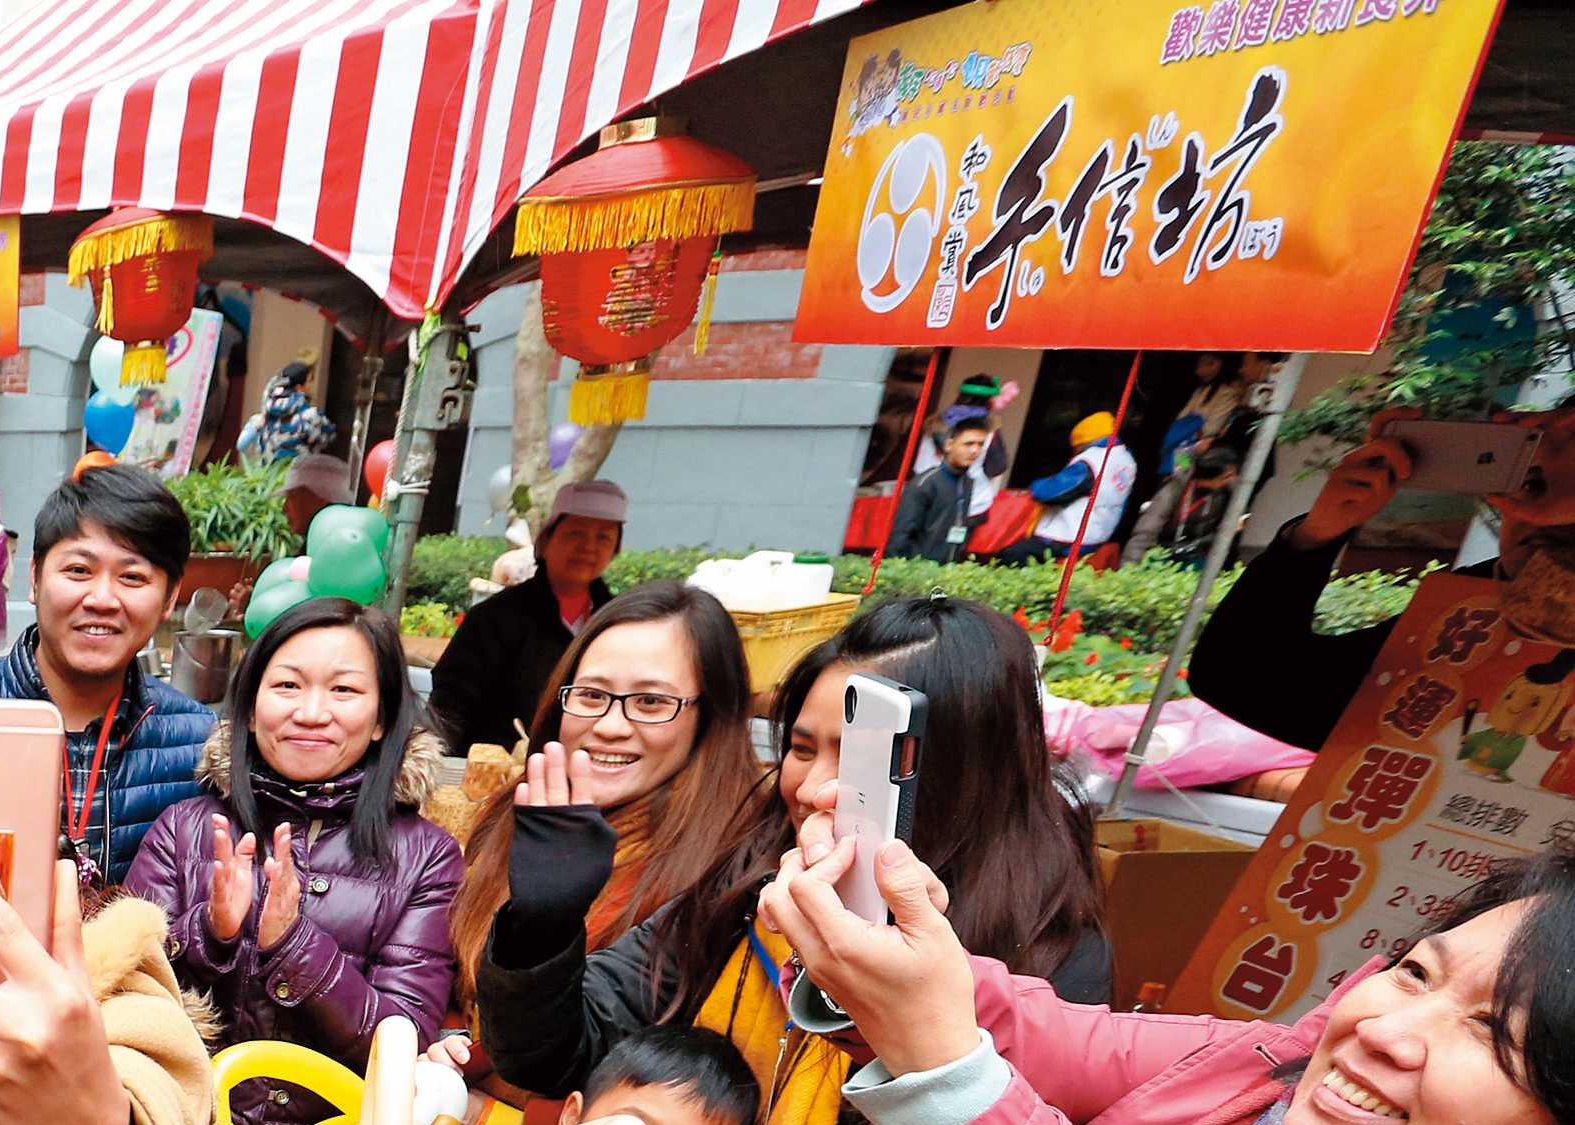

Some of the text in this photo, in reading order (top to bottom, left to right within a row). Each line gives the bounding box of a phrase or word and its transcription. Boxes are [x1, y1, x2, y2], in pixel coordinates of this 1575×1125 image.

[1160, 0, 1439, 64] 歡樂健康新
[961, 65, 1286, 328] 手信坊
[1222, 604, 1501, 1013] 好運彈珠台
[1437, 793, 1529, 835] 總排數
